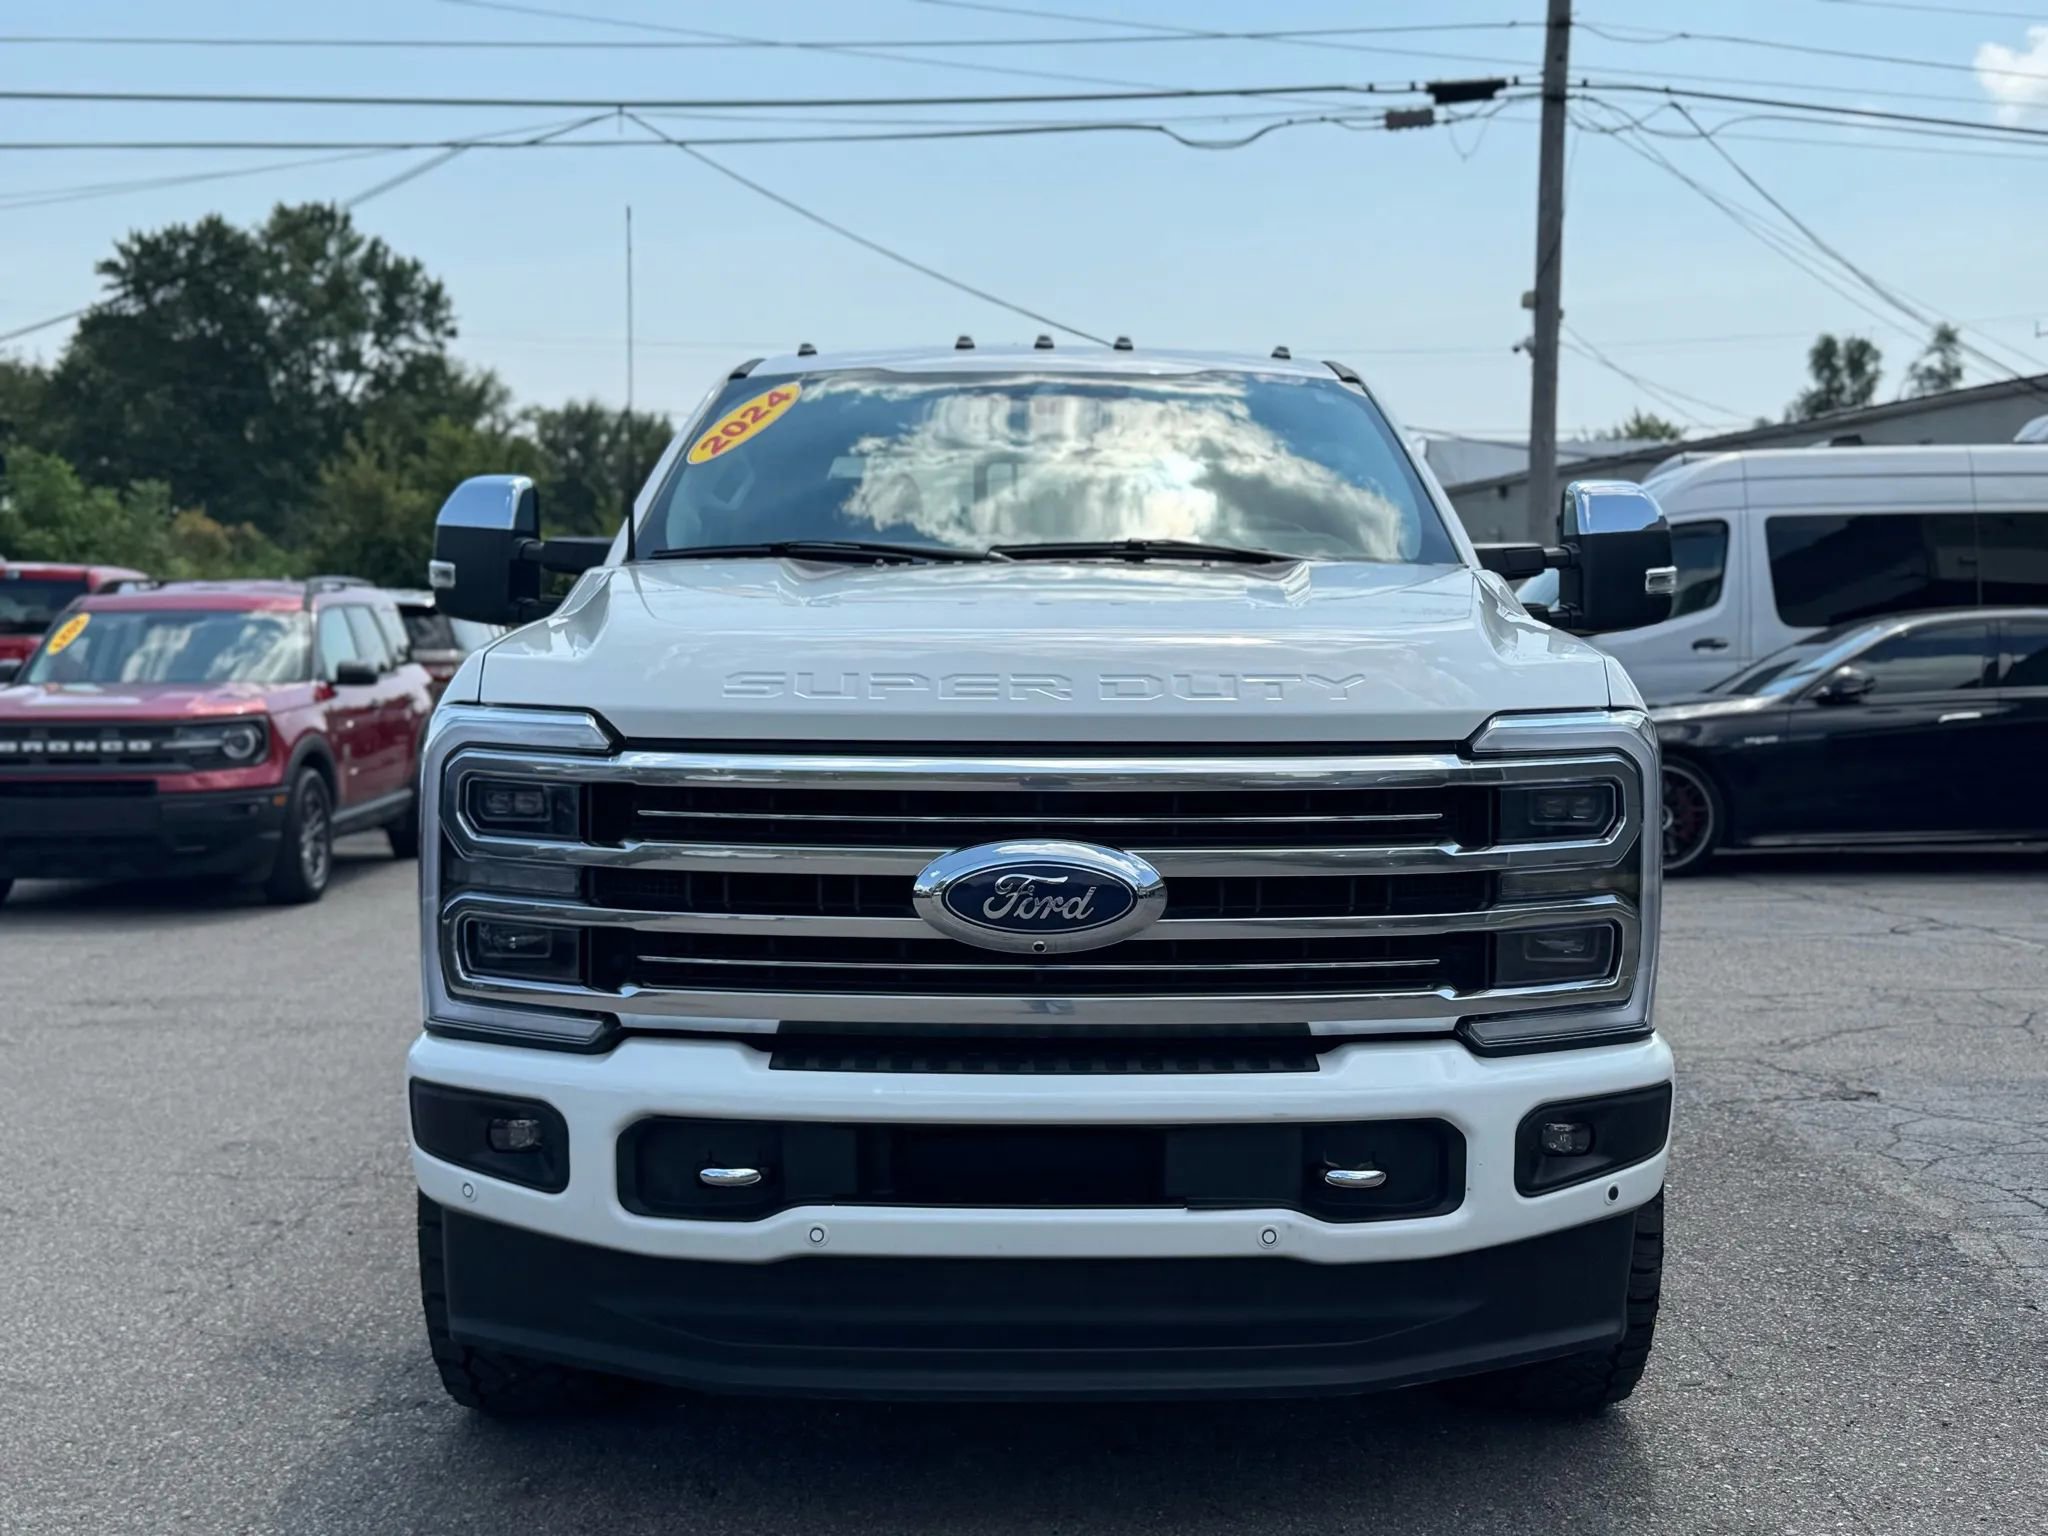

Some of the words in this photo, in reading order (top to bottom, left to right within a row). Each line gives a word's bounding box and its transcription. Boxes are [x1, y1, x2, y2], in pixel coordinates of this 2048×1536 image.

[700, 391, 791, 455] 2024
[722, 672, 1073, 700] SUPER
[1099, 673, 1366, 701] DUTY
[982, 873, 1097, 920] Ford
